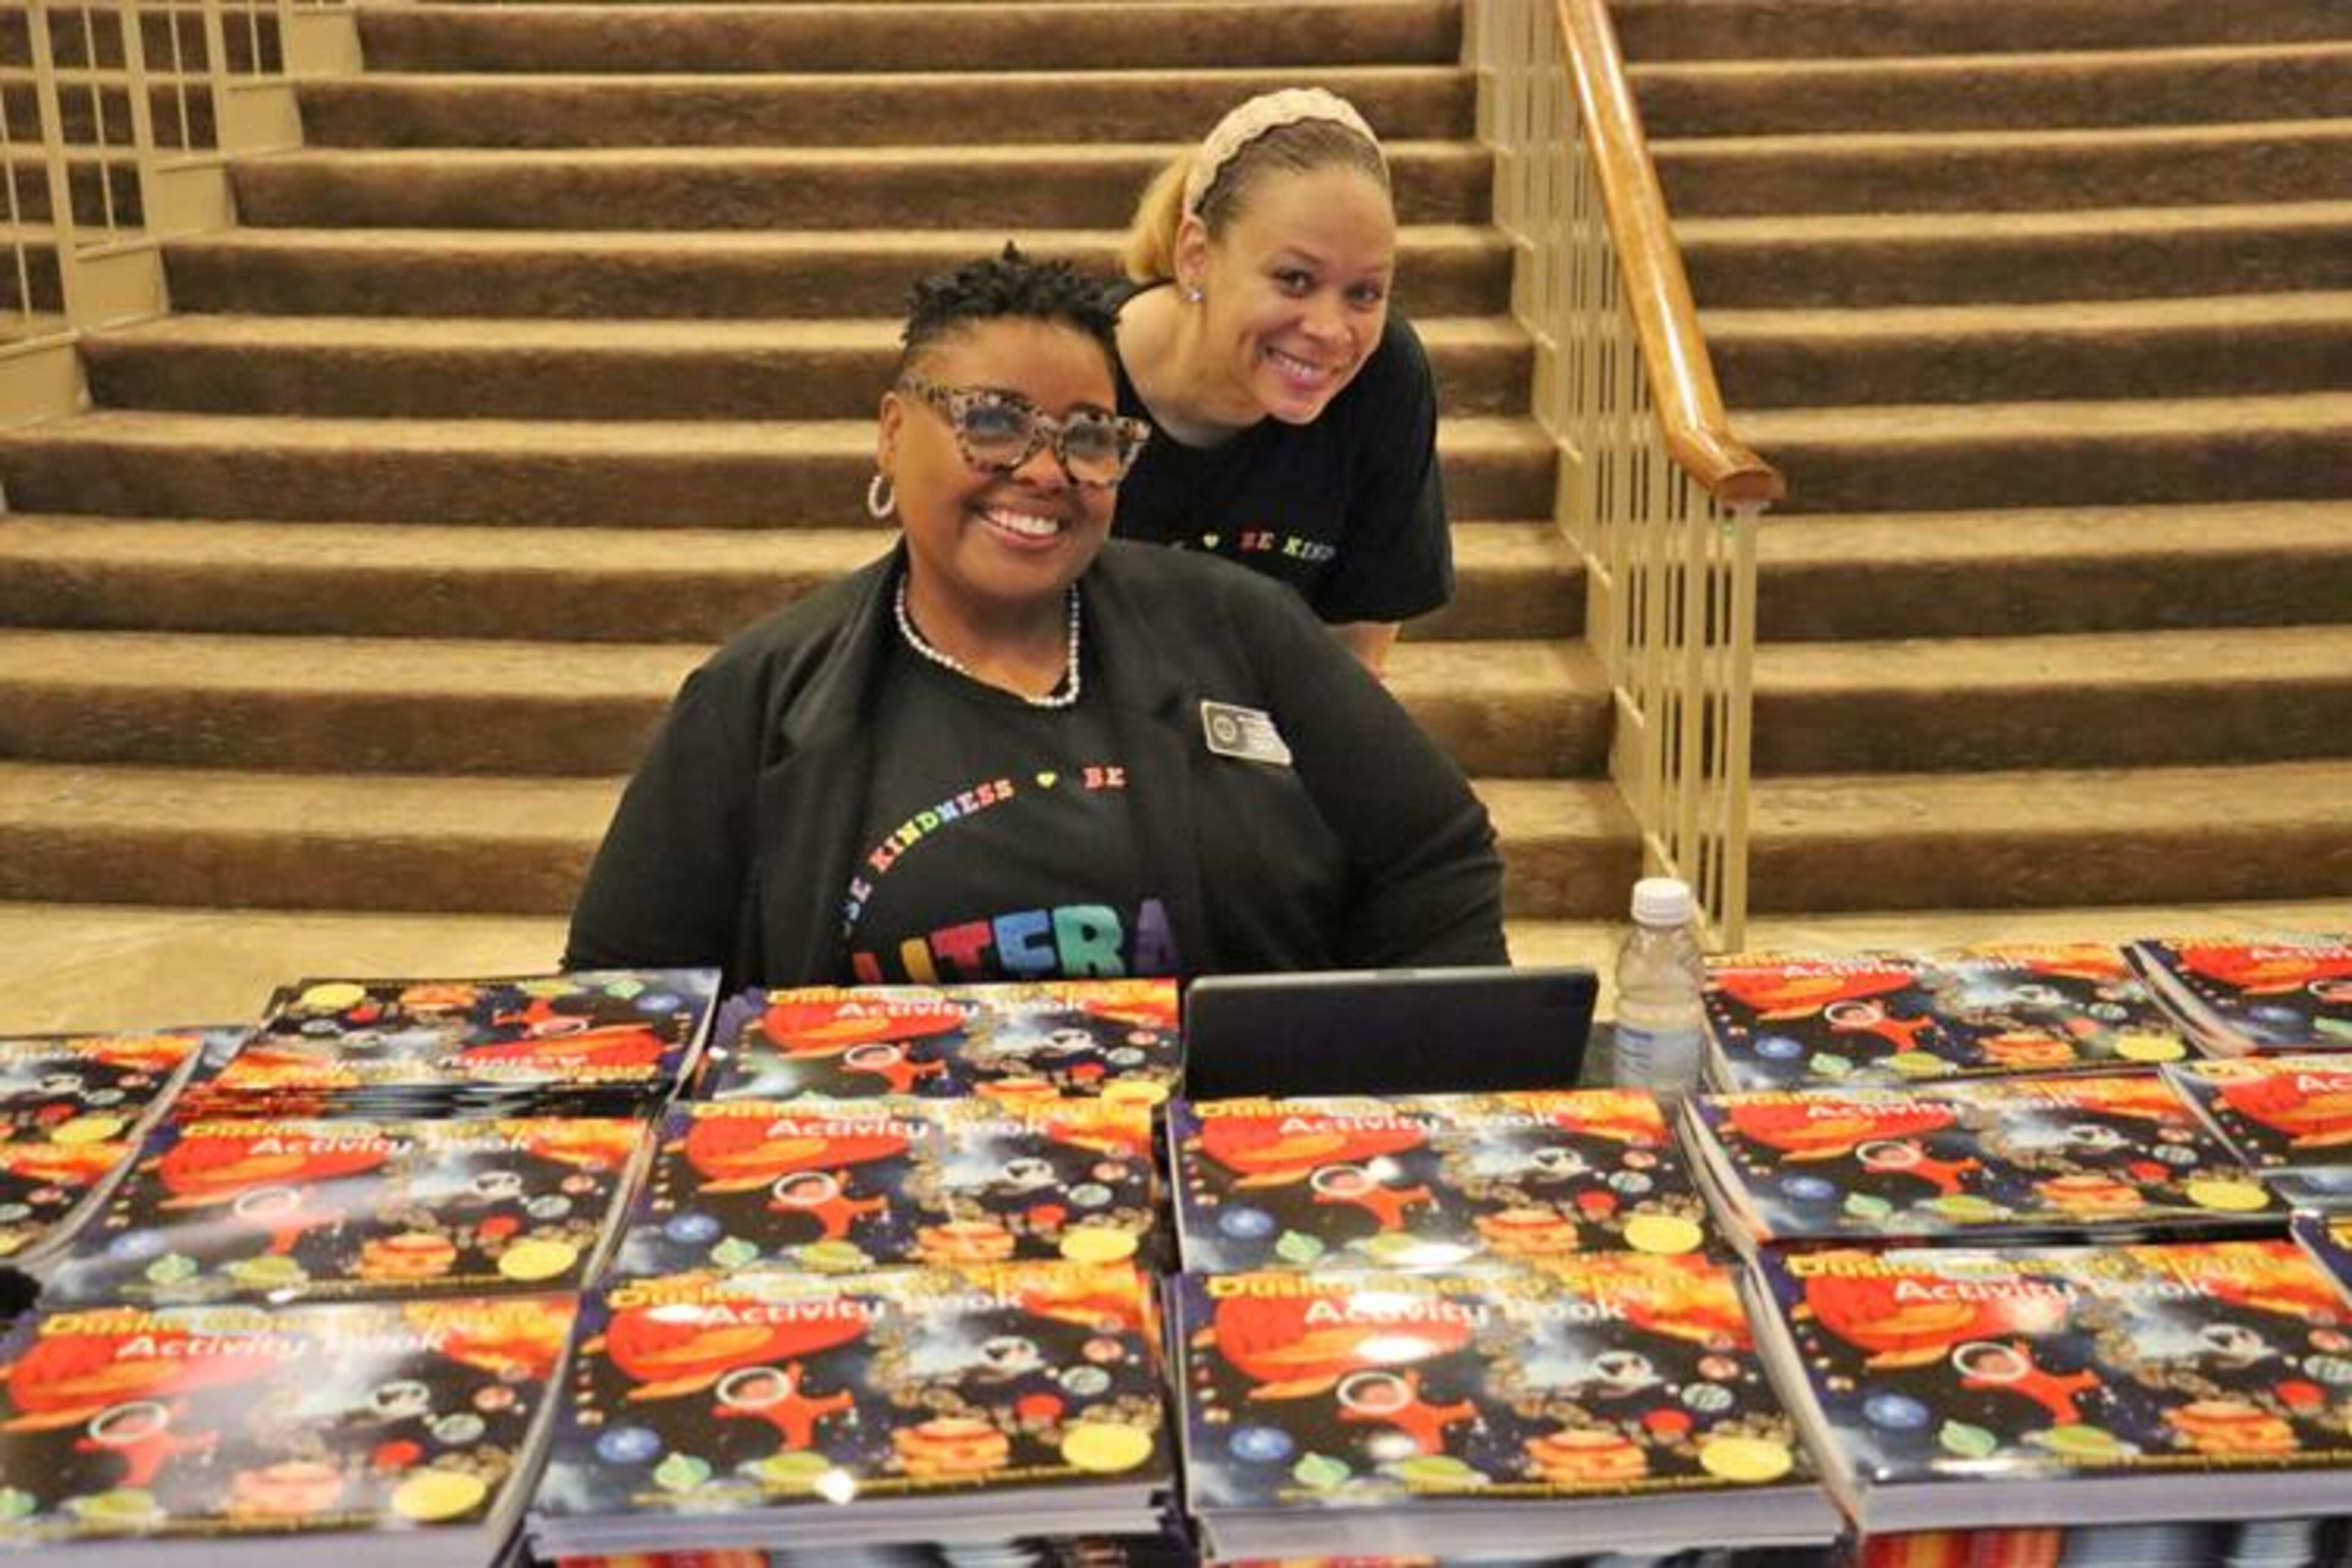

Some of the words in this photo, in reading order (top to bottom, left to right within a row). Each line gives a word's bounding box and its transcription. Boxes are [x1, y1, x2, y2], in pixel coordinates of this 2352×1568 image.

[867, 778, 1014, 872] KINDNESS
[767, 1118, 929, 1140] Activity
[249, 1136, 413, 1157] Activity
[1894, 1278, 2077, 1308] Activity
[702, 1300, 886, 1327] Activity
[1305, 1298, 1489, 1328] Activity
[115, 1334, 309, 1361] Activity
